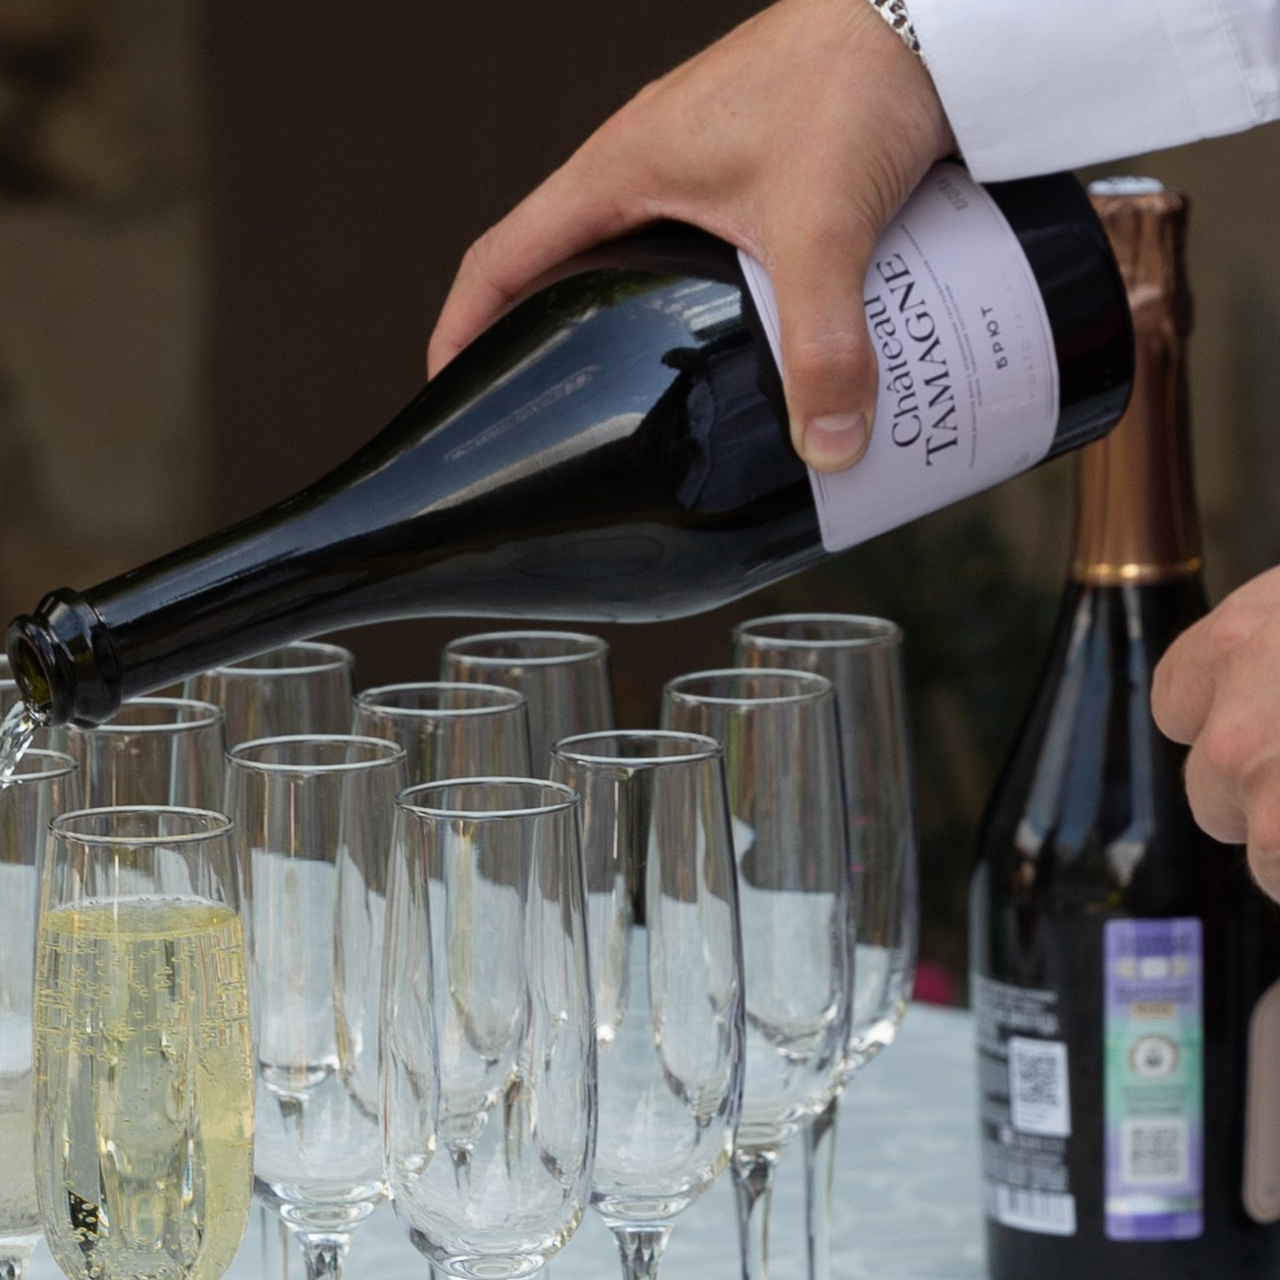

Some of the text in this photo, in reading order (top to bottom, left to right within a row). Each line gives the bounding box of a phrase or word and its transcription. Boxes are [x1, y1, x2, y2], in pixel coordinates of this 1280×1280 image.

[865, 295, 923, 448] Château
[876, 253, 959, 466] TAMAGNE
[981, 307, 1009, 370] БРЮТ
